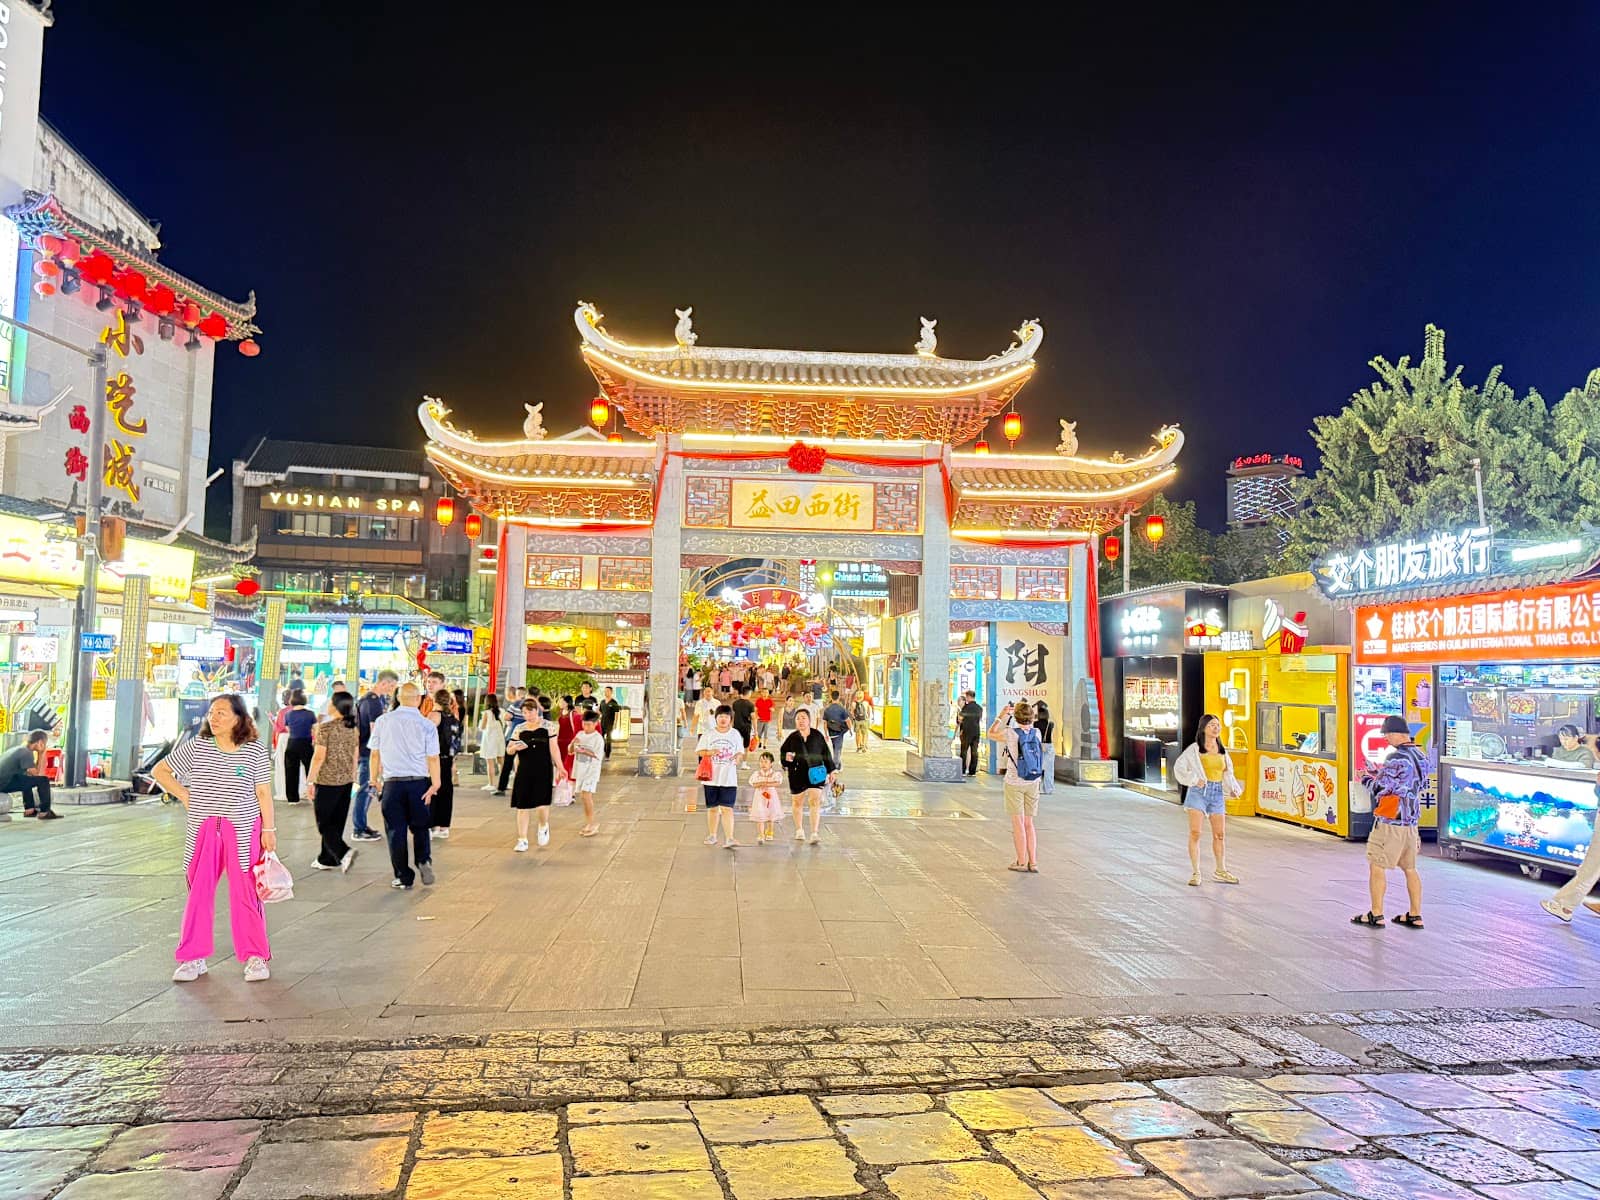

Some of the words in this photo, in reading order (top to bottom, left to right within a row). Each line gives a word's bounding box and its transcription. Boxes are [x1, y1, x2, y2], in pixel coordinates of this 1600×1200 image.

[270, 491, 361, 509] YUJIAN
[376, 498, 420, 512] SPA
[745, 489, 860, 520] 益田西街
[1327, 526, 1491, 594] 交个朋友旅行
[1535, 632, 1570, 646] TRAVEL
[1004, 639, 1050, 686] 阳
[1002, 688, 1047, 697] YANGSHUO
